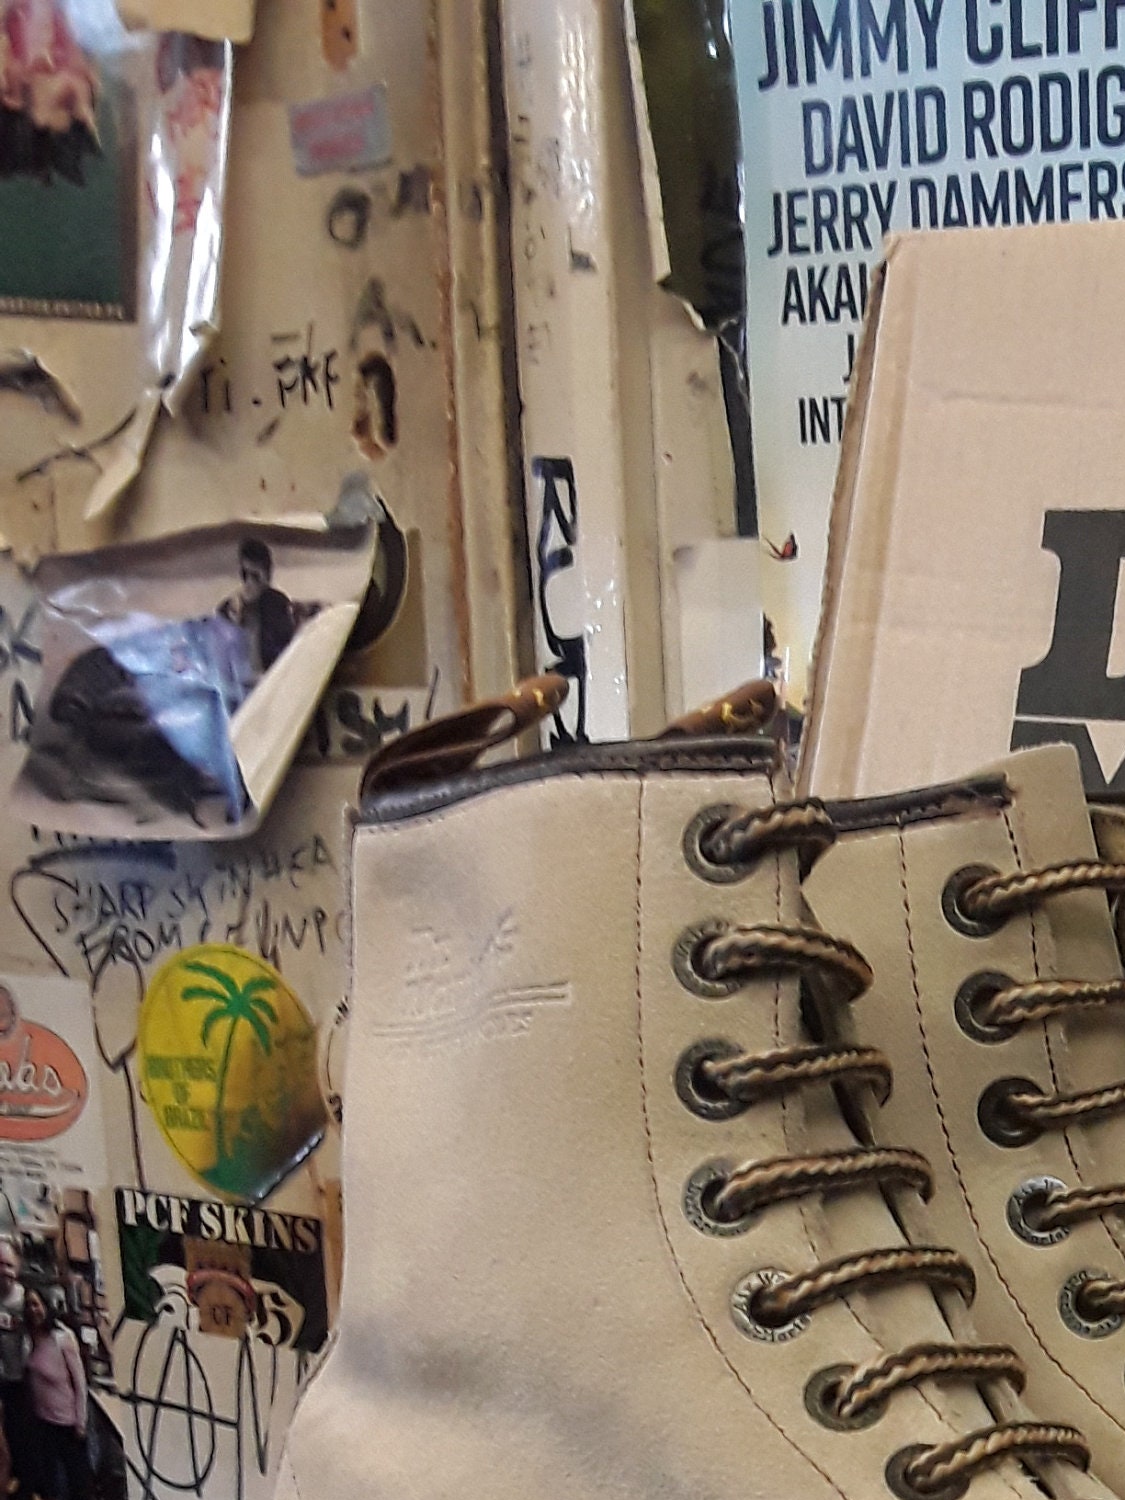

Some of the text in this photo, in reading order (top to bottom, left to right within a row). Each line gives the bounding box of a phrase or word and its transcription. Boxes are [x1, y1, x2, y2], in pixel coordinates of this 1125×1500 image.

[758, 0, 942, 90] JIMMY
[802, 87, 948, 178] DAVID
[767, 180, 898, 258] JERRY
[122, 1188, 321, 1253] PCF SKINS
